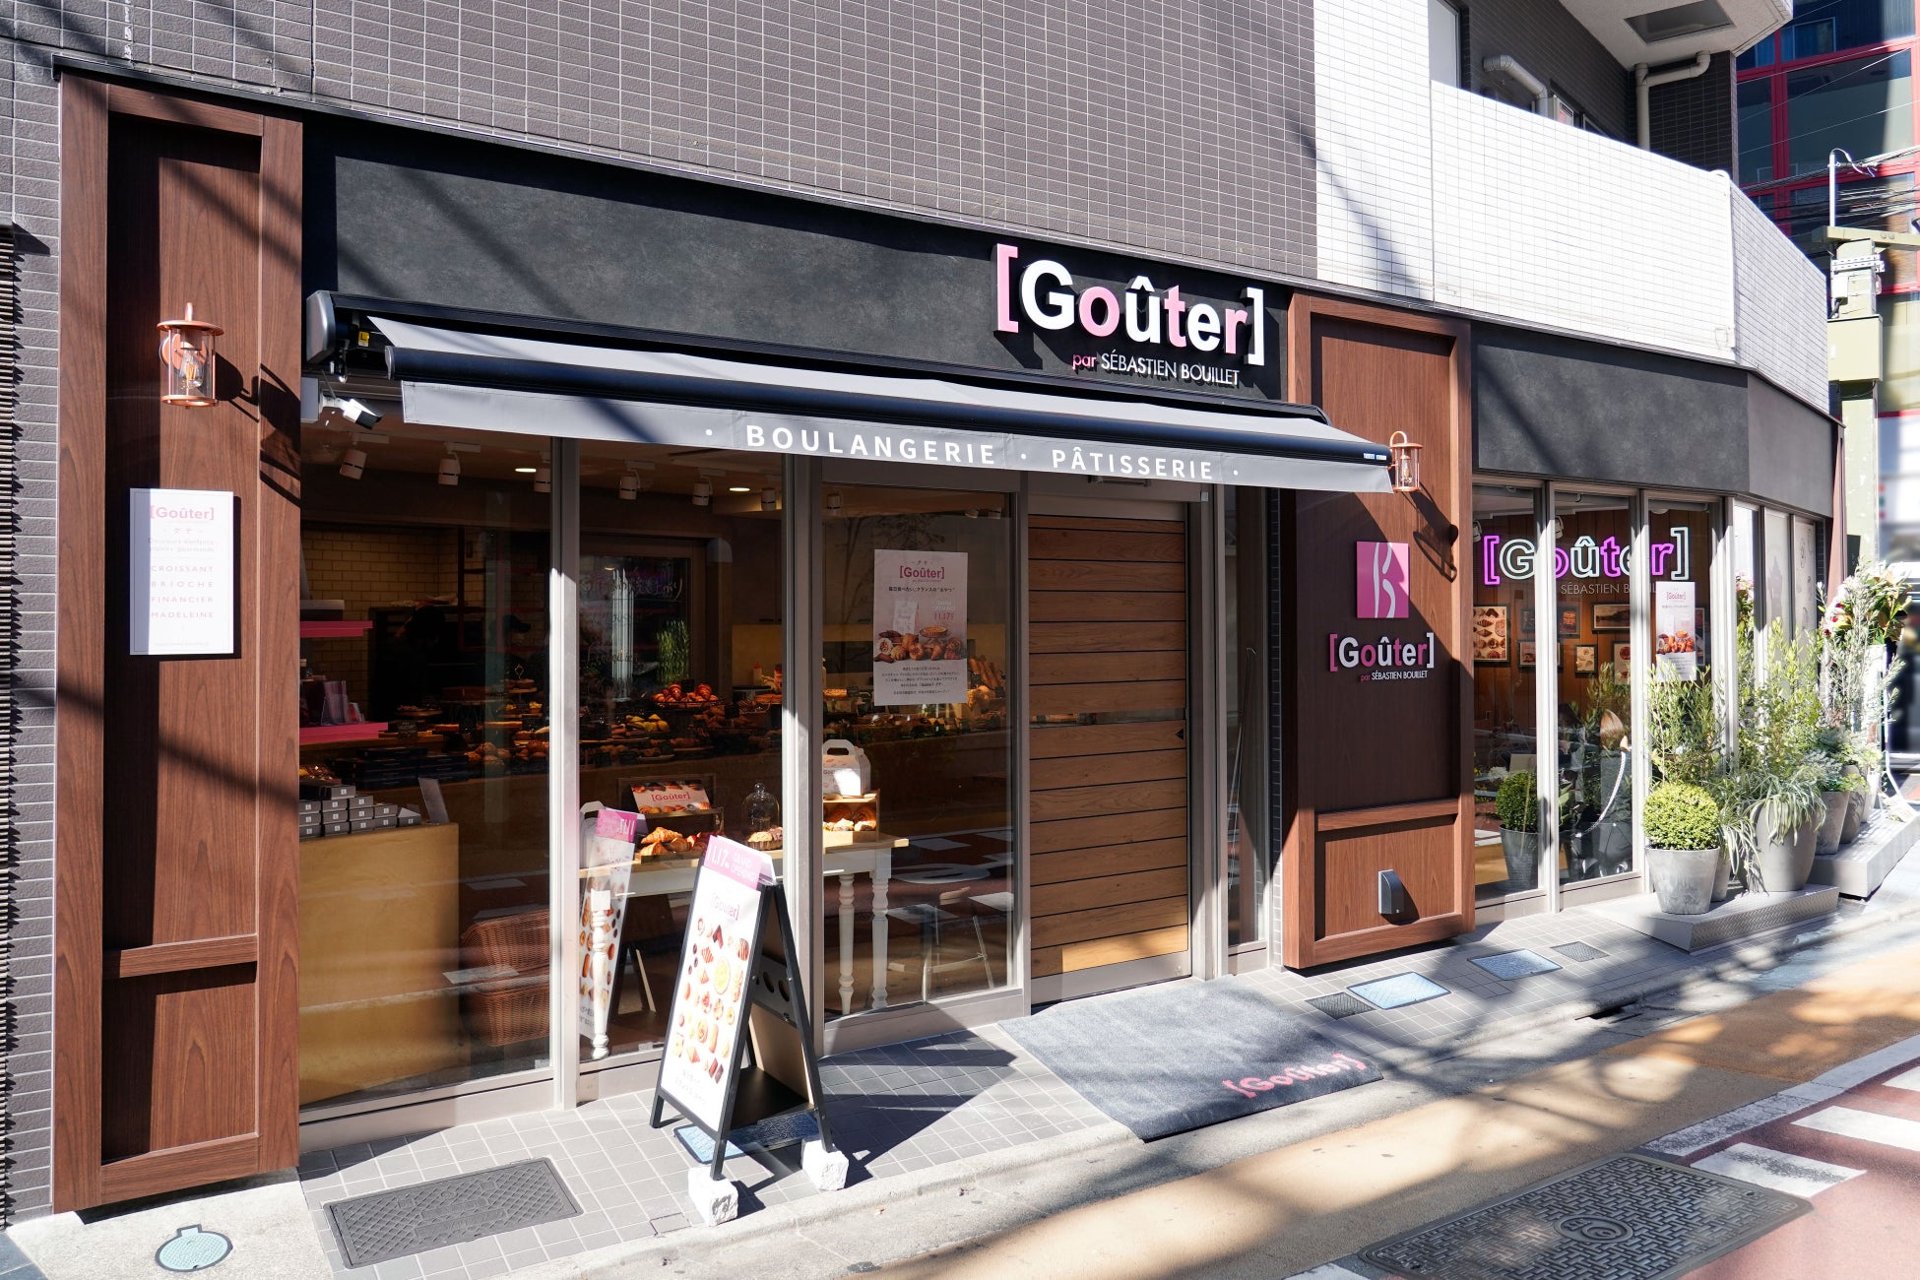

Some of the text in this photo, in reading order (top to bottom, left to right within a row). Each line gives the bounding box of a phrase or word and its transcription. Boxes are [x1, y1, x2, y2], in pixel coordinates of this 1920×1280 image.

[995, 243, 1264, 366] [Goûter]
[1072, 350, 1240, 386] par SÉBASTIEN BOUILLET
[746, 425, 995, 465] BOULANGERIE
[1052, 447, 1213, 480] PÂTISSERIE
[1560, 582, 1620, 595] SÉBASTIEN
[1329, 632, 1435, 672] [Goûter]
[1371, 669, 1402, 681] SÉBASTIEN
[1403, 670, 1428, 679] BOUILLET
